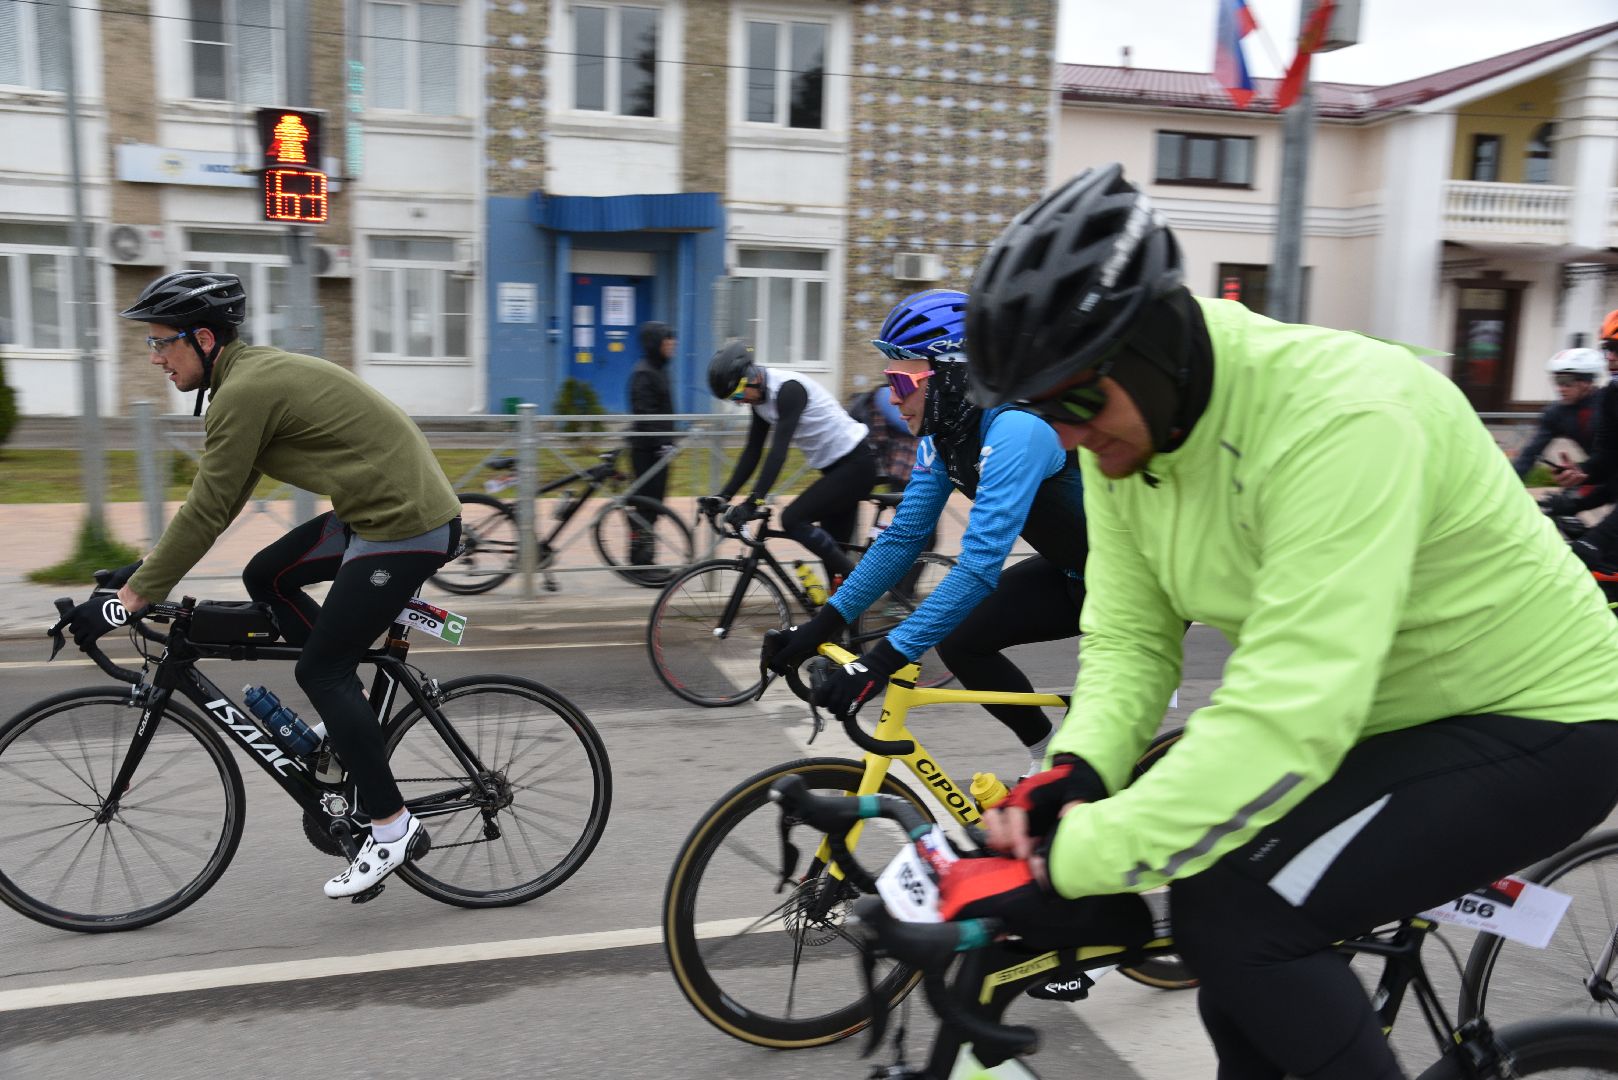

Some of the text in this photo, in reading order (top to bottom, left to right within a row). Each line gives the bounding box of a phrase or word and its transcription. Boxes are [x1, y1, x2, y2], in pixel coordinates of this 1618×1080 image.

[408, 612, 438, 629] 070
[138, 708, 152, 737] ISAAC
[204, 698, 303, 778] ISAAC
[1454, 897, 1495, 918] 156
